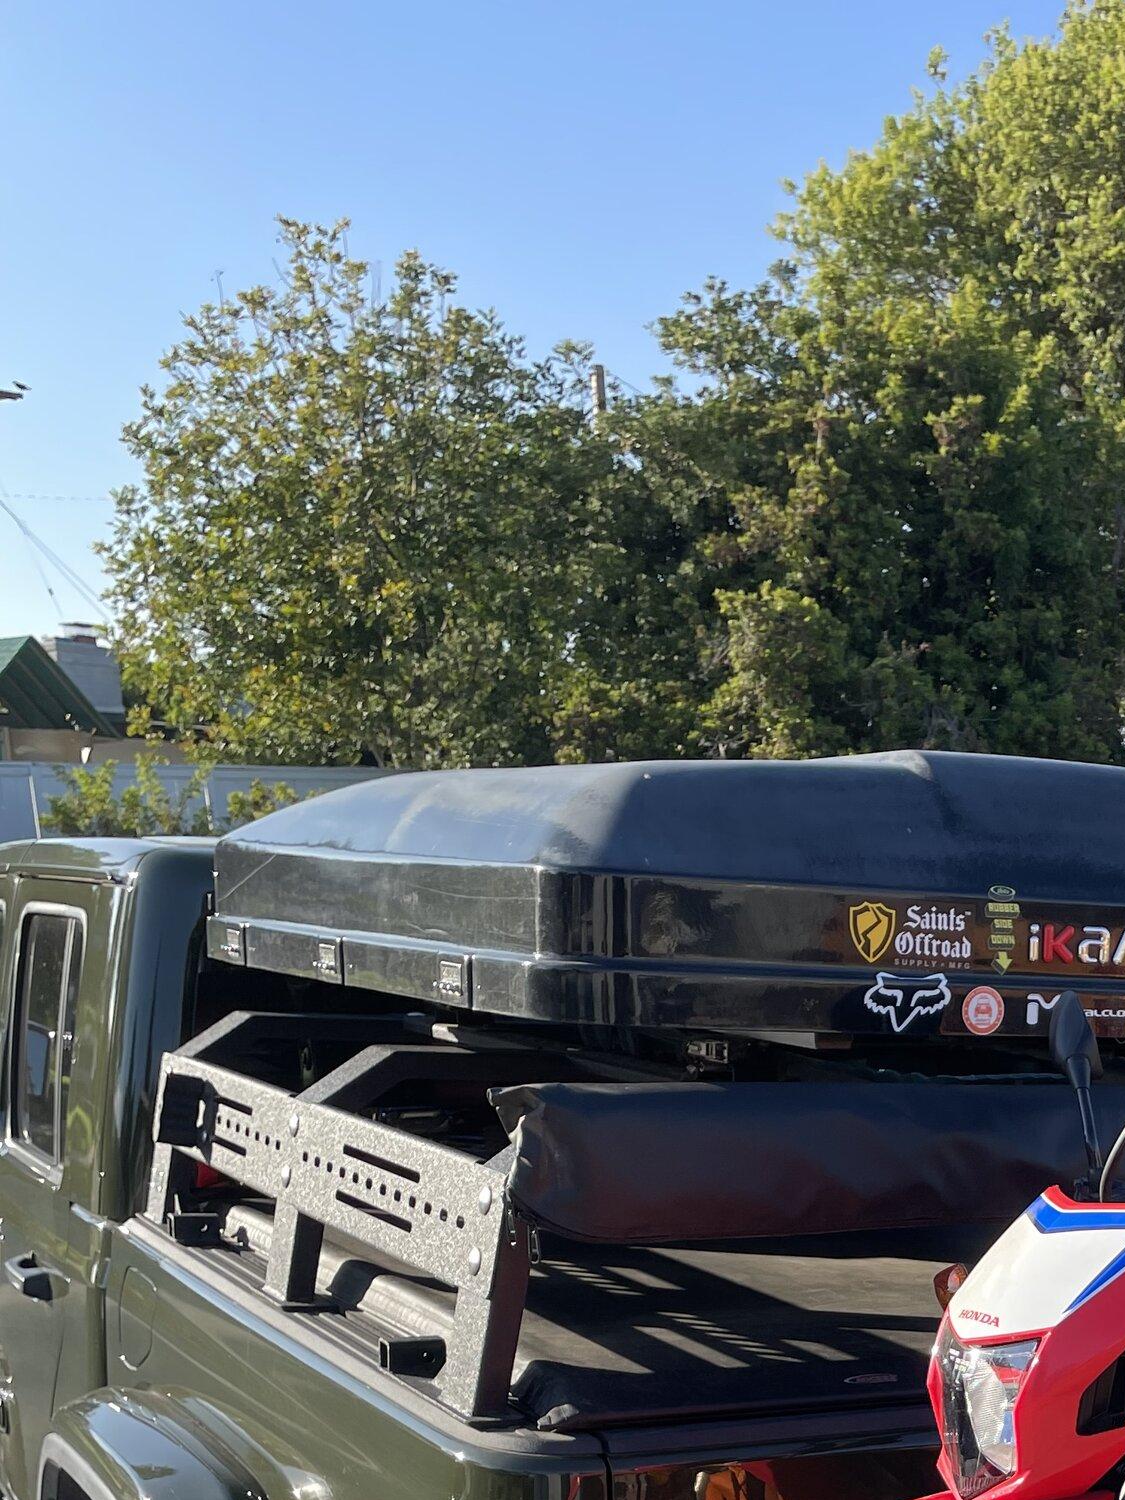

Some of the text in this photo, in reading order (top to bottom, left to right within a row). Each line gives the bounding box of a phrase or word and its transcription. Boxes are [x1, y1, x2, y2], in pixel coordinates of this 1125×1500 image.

[993, 919, 1013, 928] SIDE
[894, 931, 971, 958] Offroad
[894, 958, 971, 969] SUPPLY MFG
[958, 1309, 999, 1328] HONDA
